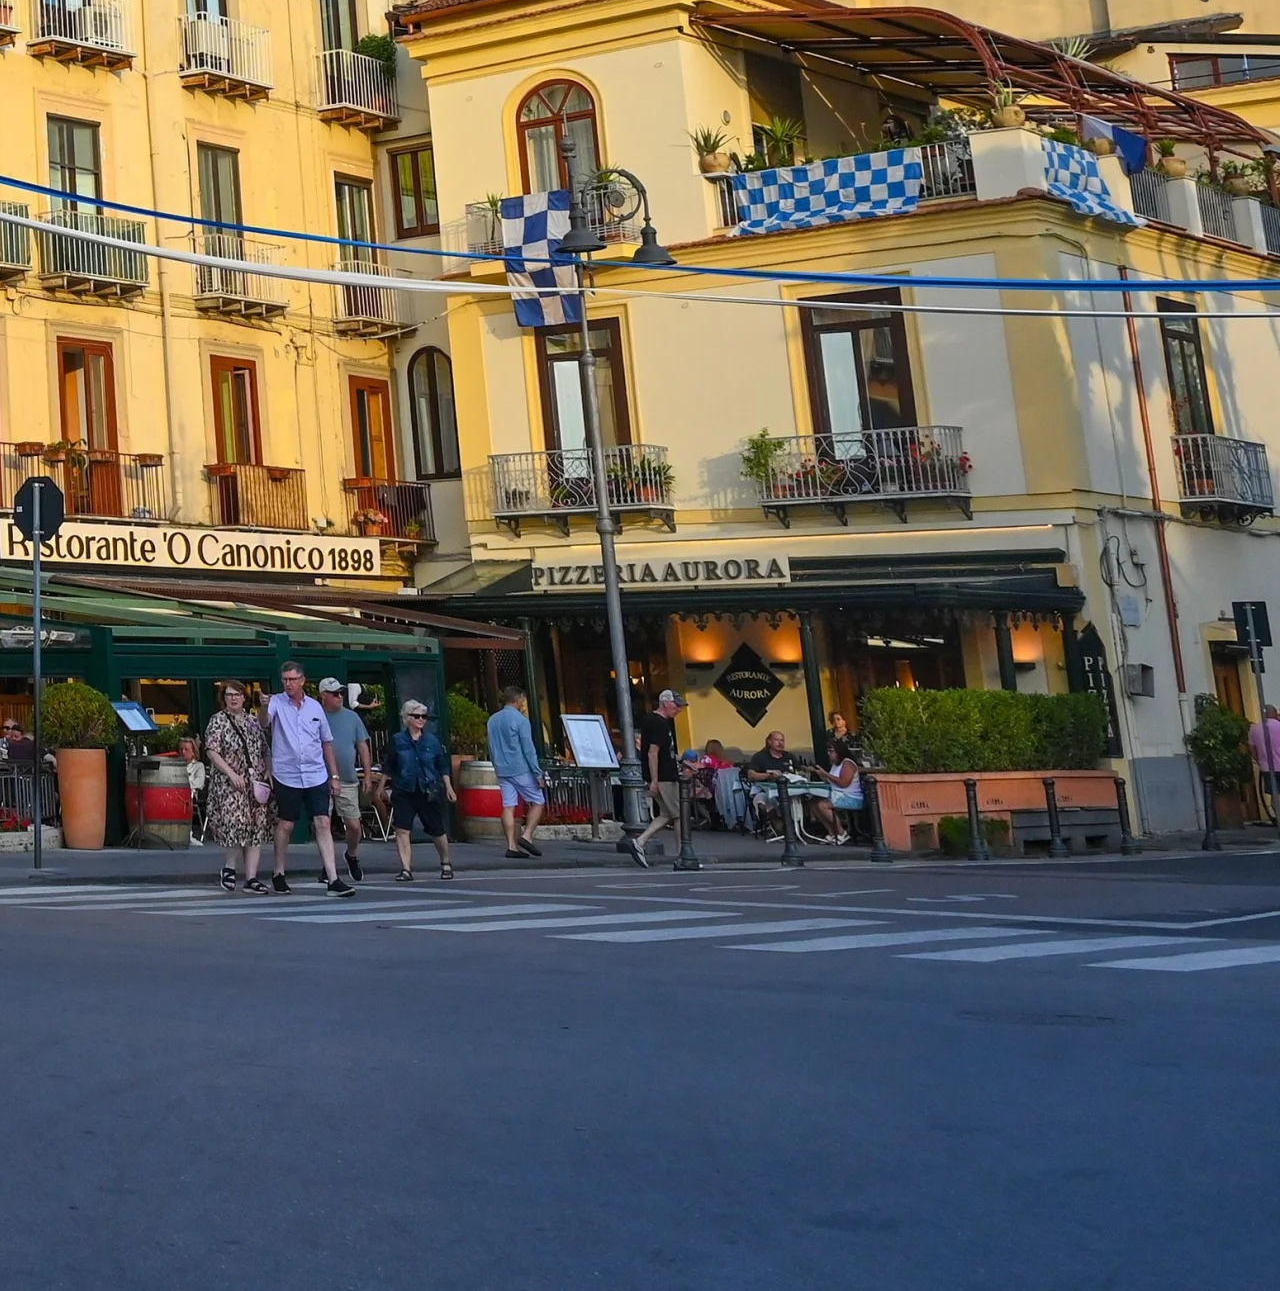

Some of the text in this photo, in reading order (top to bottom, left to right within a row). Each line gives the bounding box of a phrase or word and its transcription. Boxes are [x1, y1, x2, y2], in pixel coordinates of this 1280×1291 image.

[7, 523, 156, 563] Rstorante
[197, 534, 324, 571] Canonico
[328, 548, 375, 572] 1898
[662, 558, 787, 582] AURORA
[725, 670, 772, 683] RISTORANTE
[729, 688, 771, 699] AURORA
